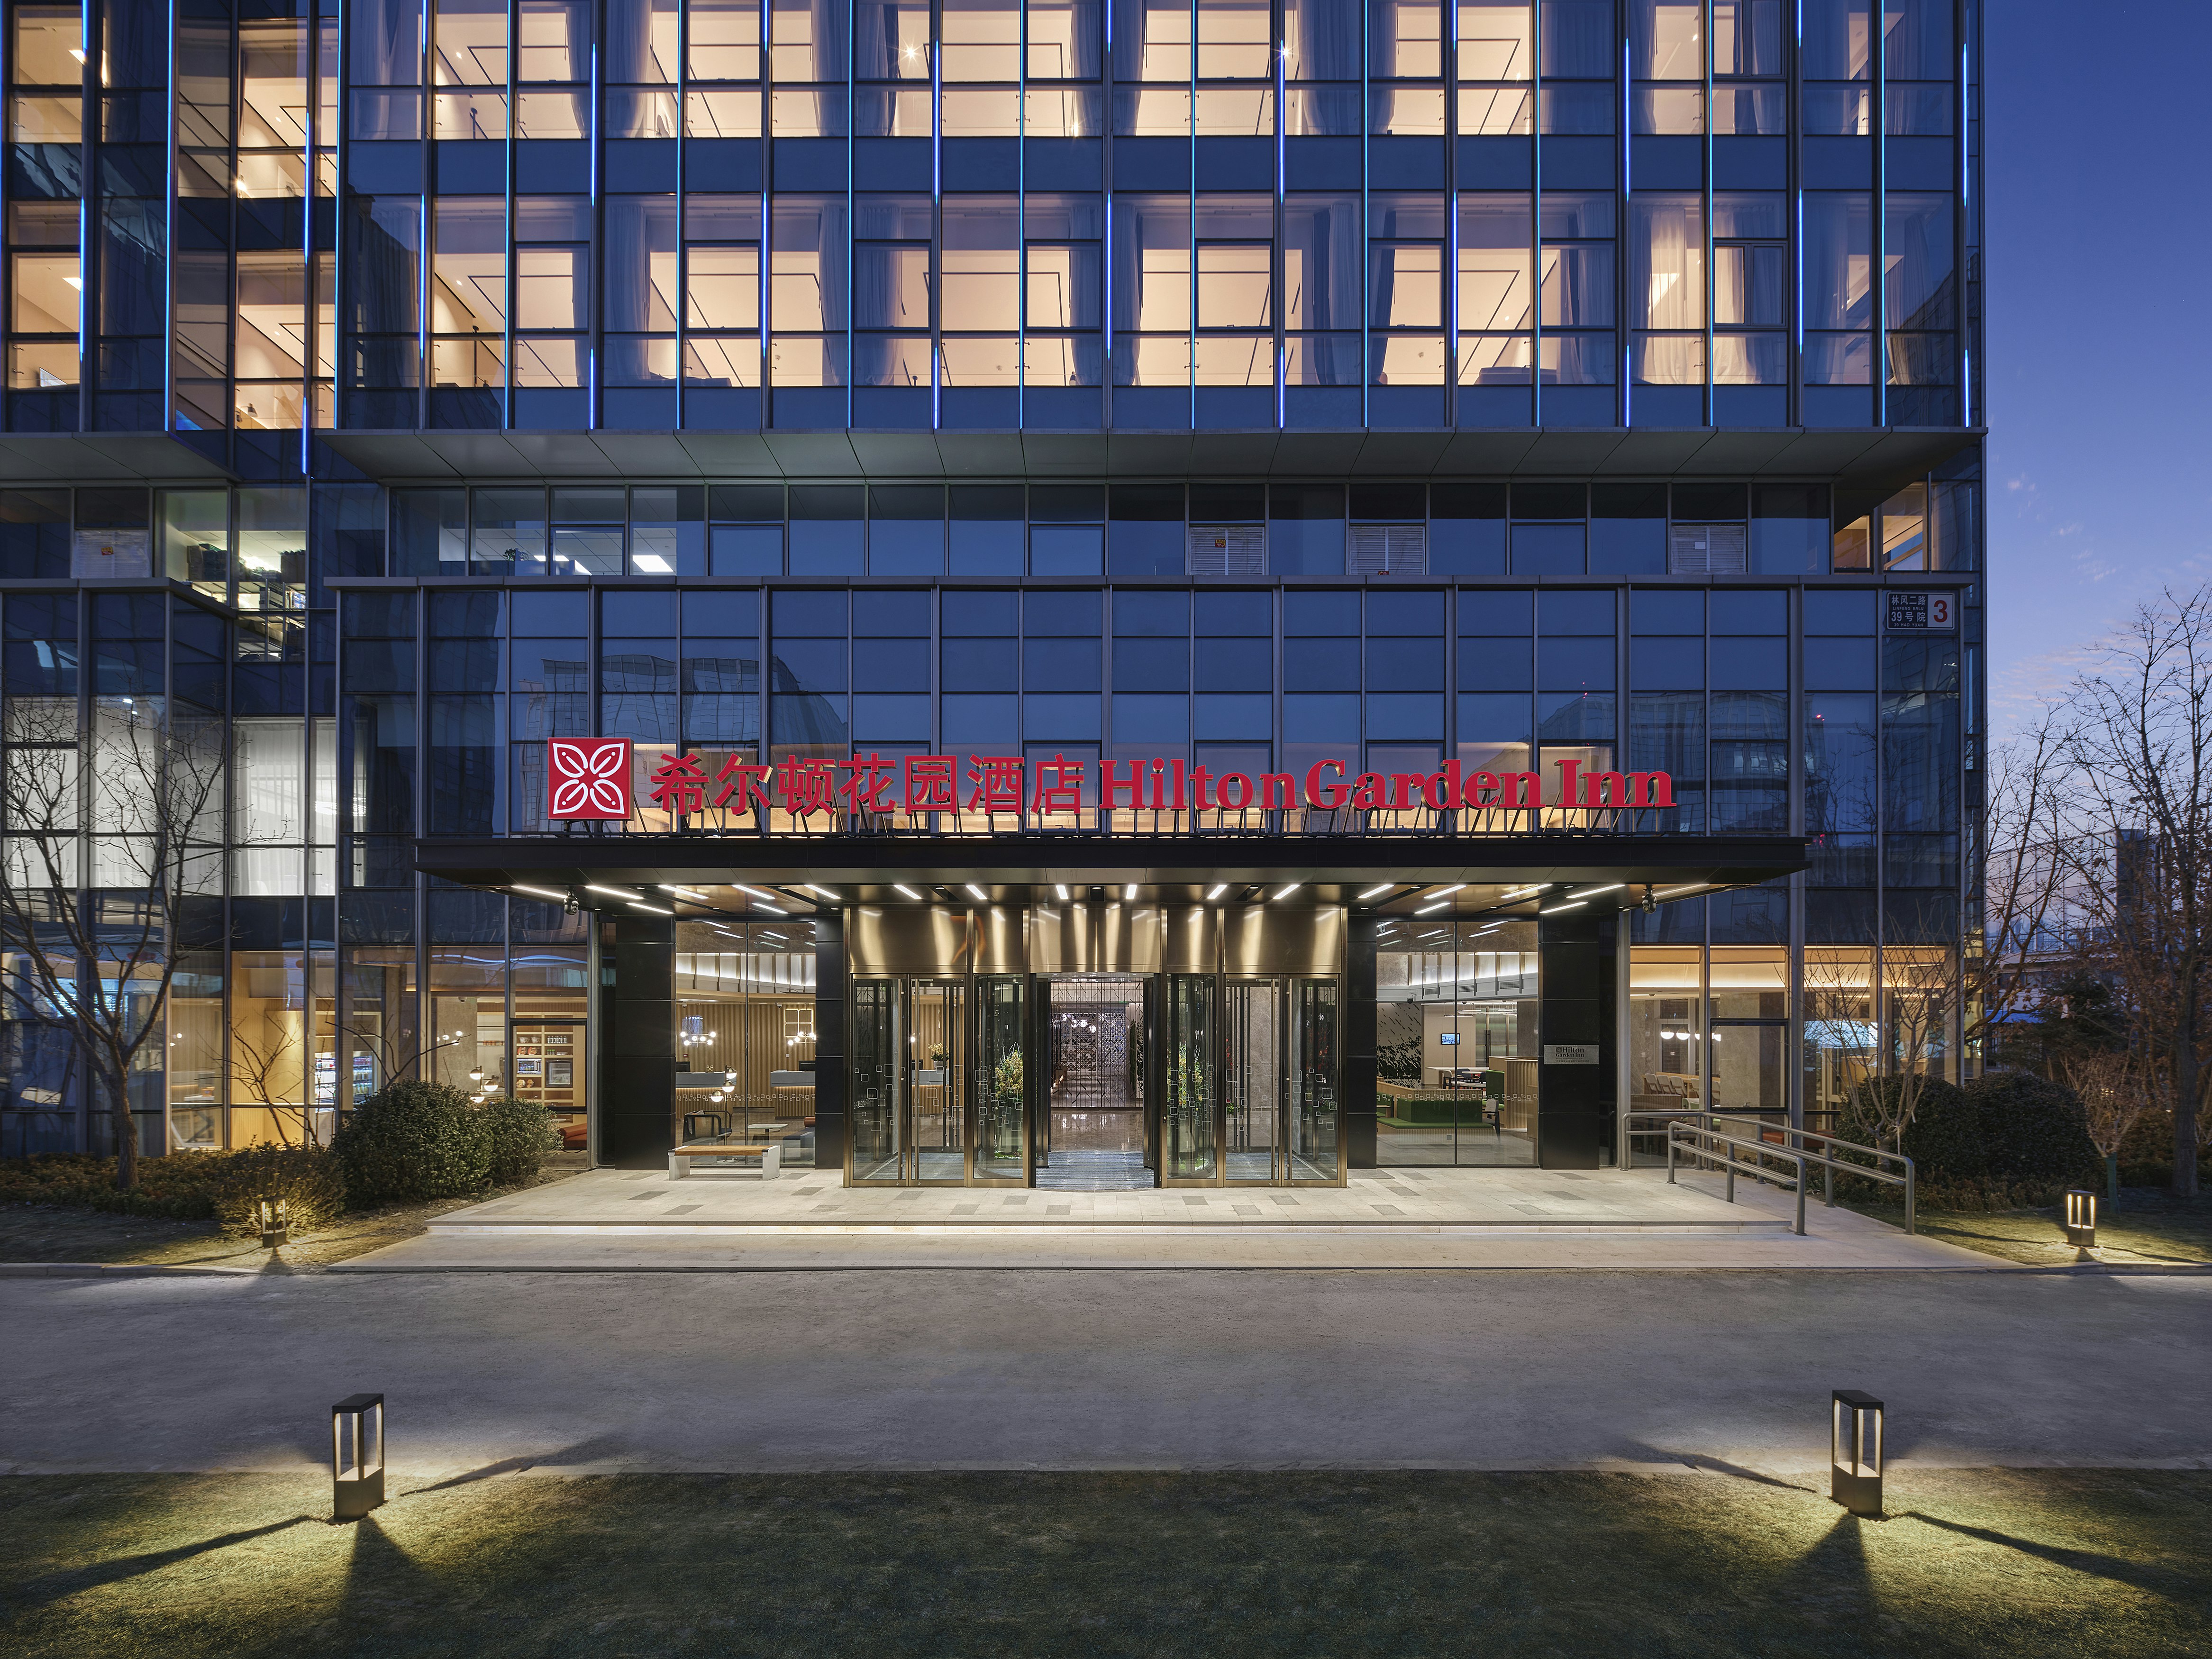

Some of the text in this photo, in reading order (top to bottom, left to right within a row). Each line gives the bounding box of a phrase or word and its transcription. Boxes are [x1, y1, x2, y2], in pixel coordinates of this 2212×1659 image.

[1891, 595, 1926, 606] 林风二路
[1933, 600, 1948, 623] 3
[1891, 611, 1926, 622] 39号院
[649, 753, 1085, 815] 希尔顿花园酒店
[1099, 758, 1677, 810] Hilton Garden Inn
